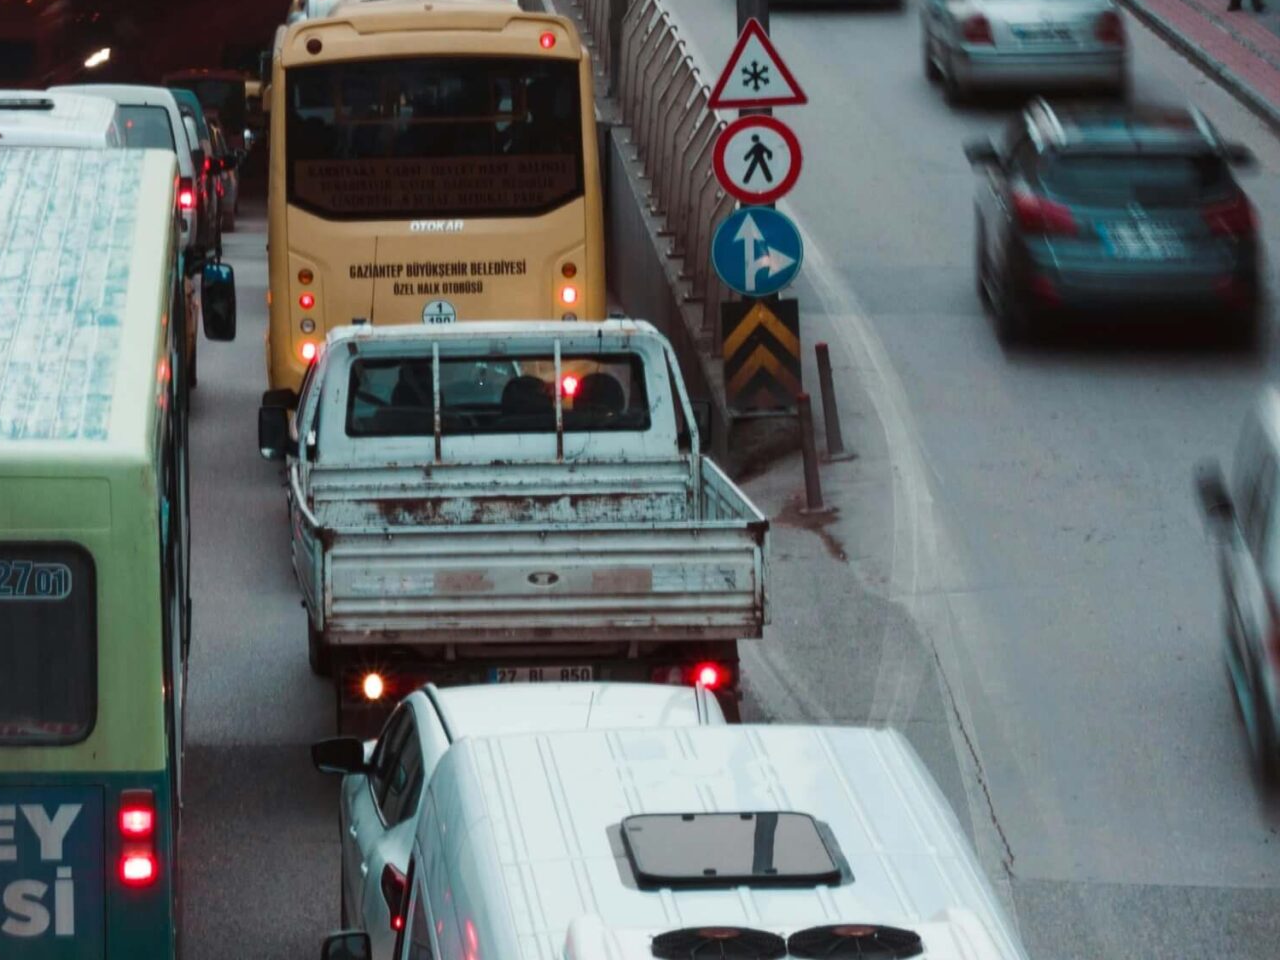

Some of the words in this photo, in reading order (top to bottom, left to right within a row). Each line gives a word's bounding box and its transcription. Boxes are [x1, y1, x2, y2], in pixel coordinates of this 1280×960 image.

[410, 219, 464, 232] OTOKAR
[350, 262, 403, 279] GAZİANTEP
[406, 260, 467, 280] BÜYÜKŞEHİR
[470, 258, 526, 277] BELEDİYESİ
[393, 281, 414, 296] ÖZEL
[417, 282, 439, 296] HALK
[442, 280, 483, 295] OTOBÜSÜ
[436, 302, 443, 313] 1
[35, 568, 65, 596] 01
[499, 669, 517, 682] 27
